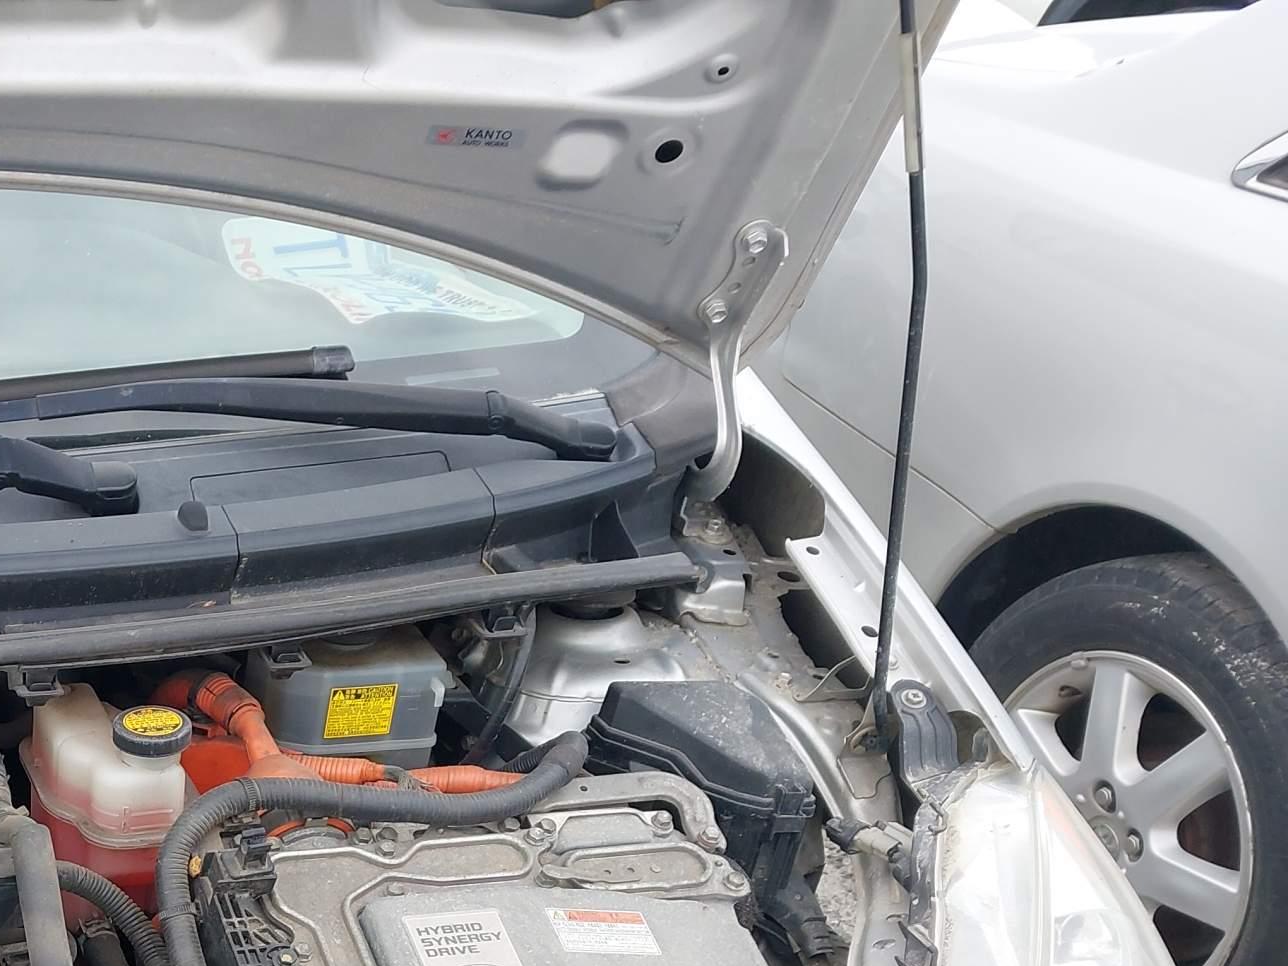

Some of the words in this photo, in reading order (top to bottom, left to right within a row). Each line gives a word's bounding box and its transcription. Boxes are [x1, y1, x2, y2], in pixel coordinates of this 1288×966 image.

[465, 128, 512, 140] KANTO
[416, 922, 483, 936] HYBRID
[421, 932, 501, 947] SYNERGY
[425, 945, 480, 957] DRIVE
